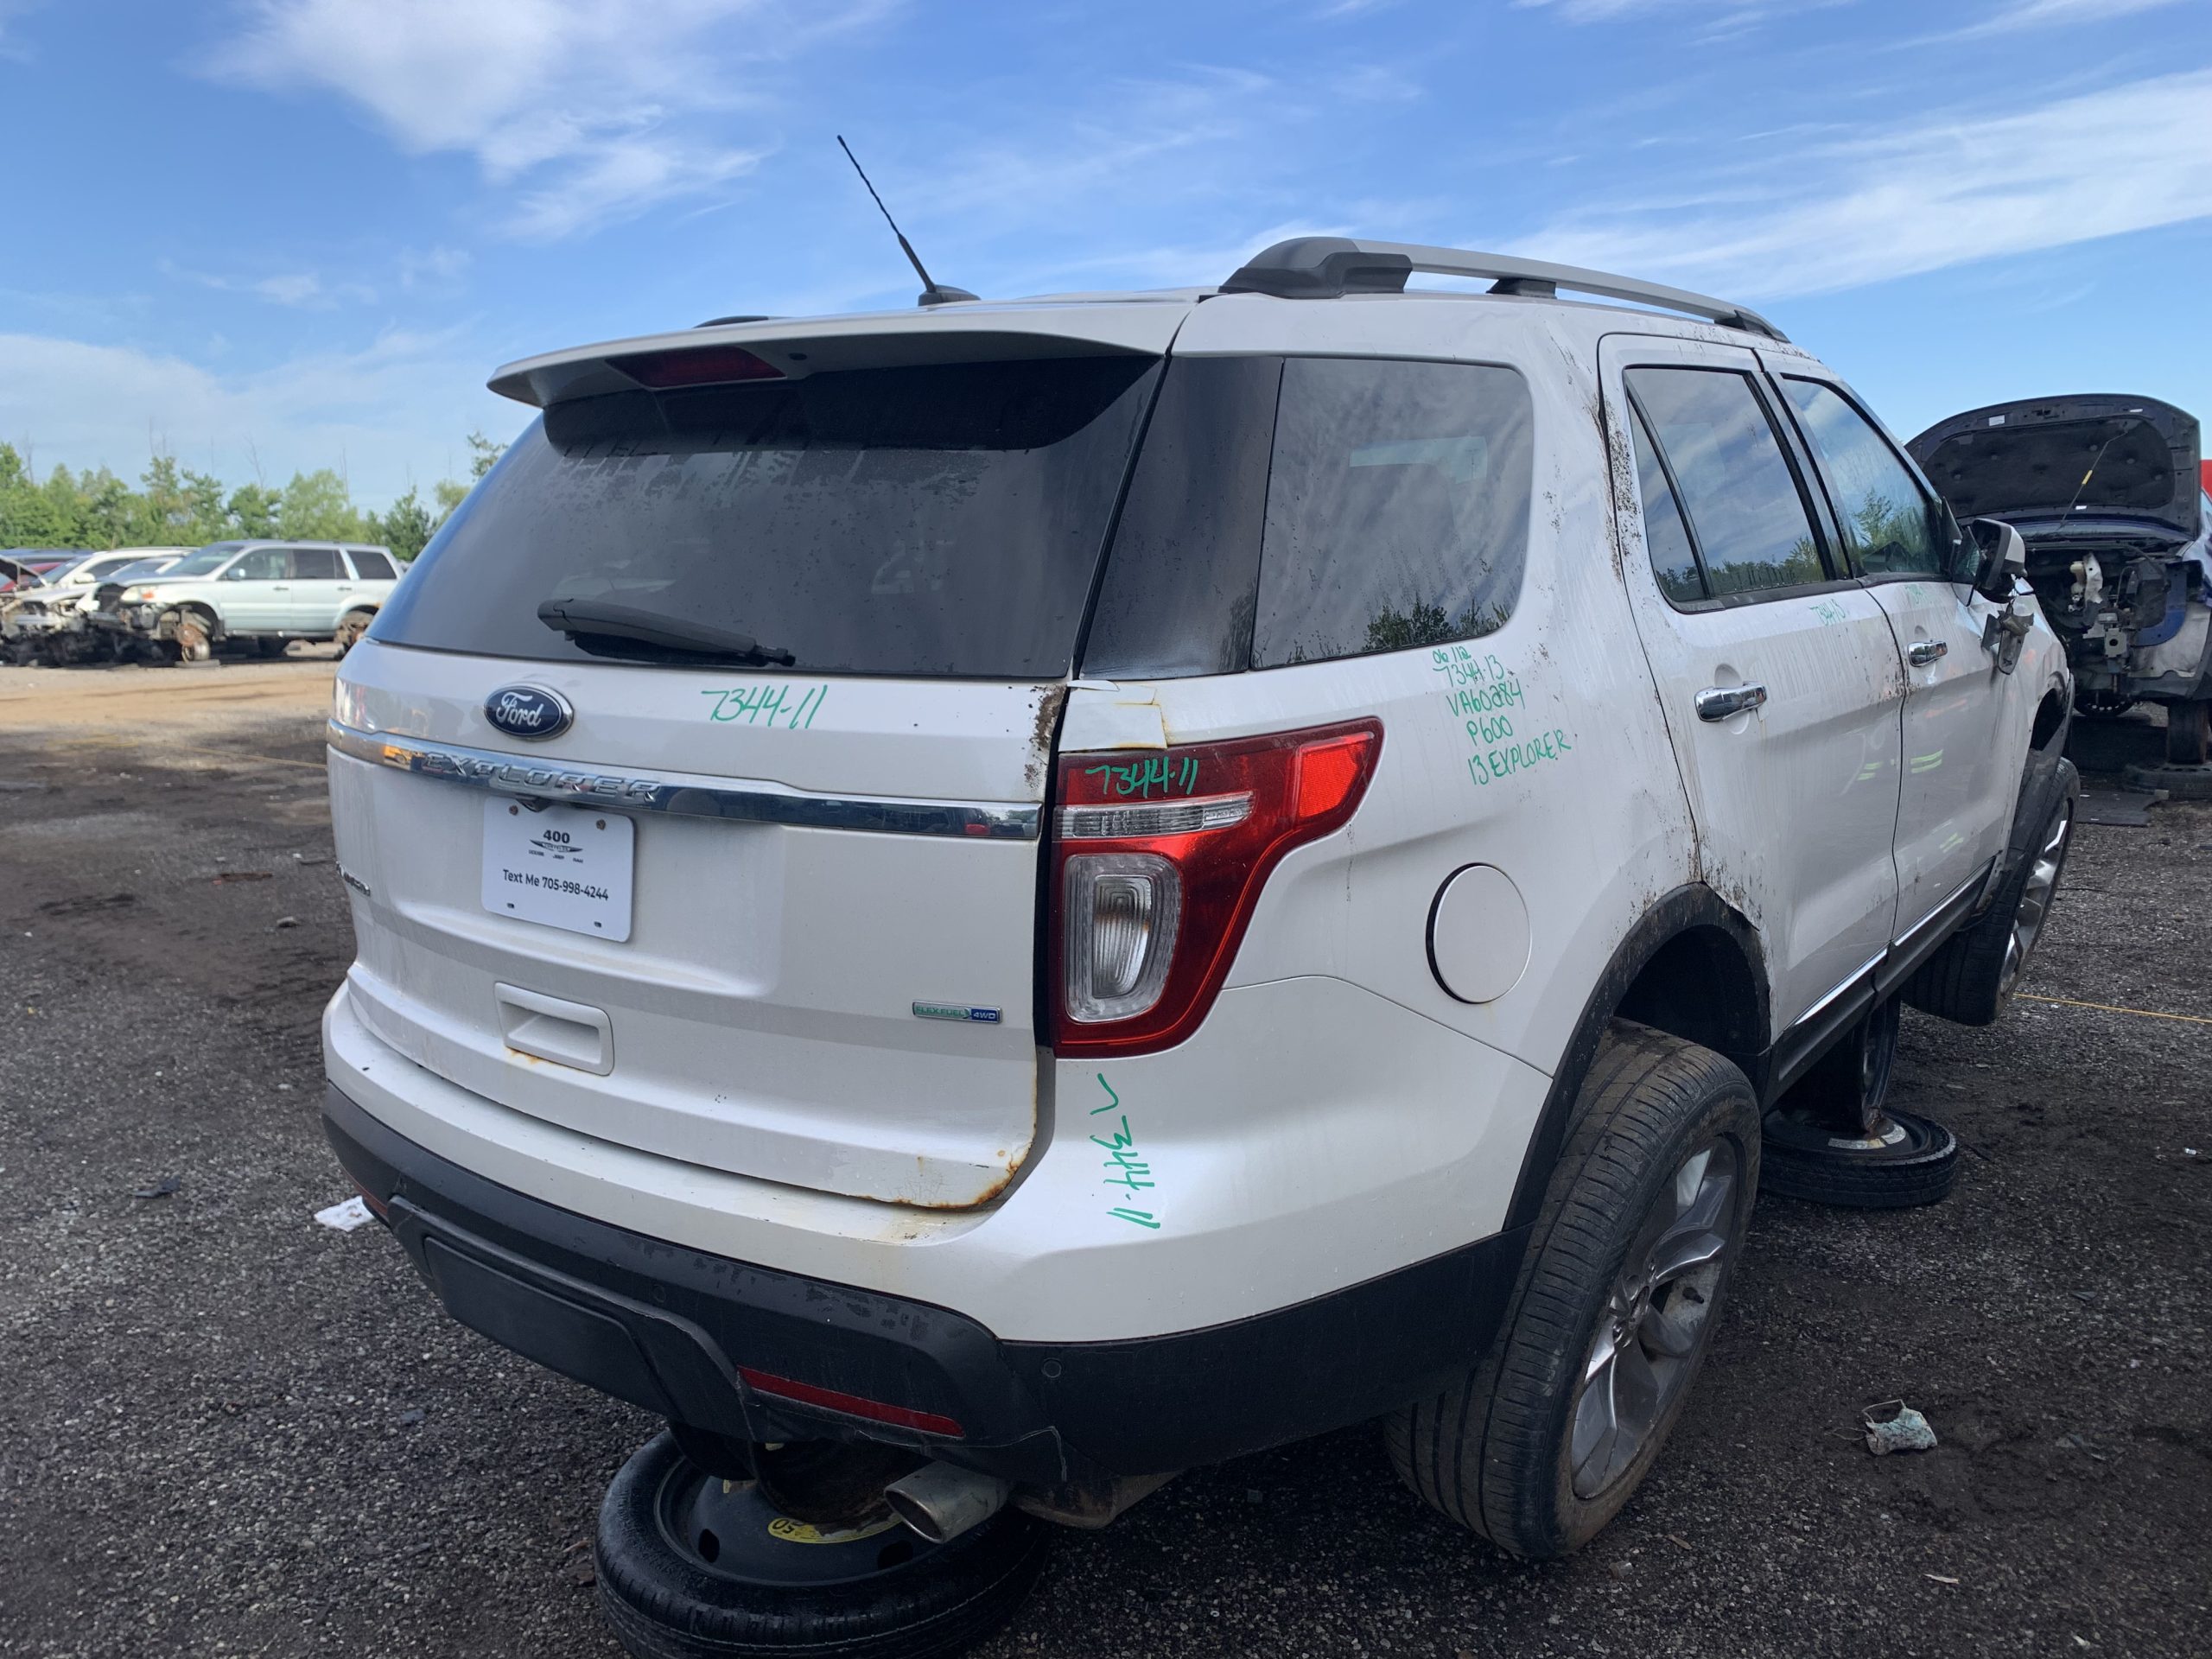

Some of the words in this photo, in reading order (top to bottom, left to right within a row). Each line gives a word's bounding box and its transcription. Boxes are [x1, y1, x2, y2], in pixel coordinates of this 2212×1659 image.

[496, 692, 544, 728] Ford
[701, 684, 828, 729] 7344-11
[421, 751, 662, 804] EXPLORER
[543, 830, 570, 844] 400
[503, 869, 523, 884] Text
[525, 874, 540, 887] Me
[542, 877, 609, 901] 705-998-4244
[973, 1010, 996, 1020] 4WD
